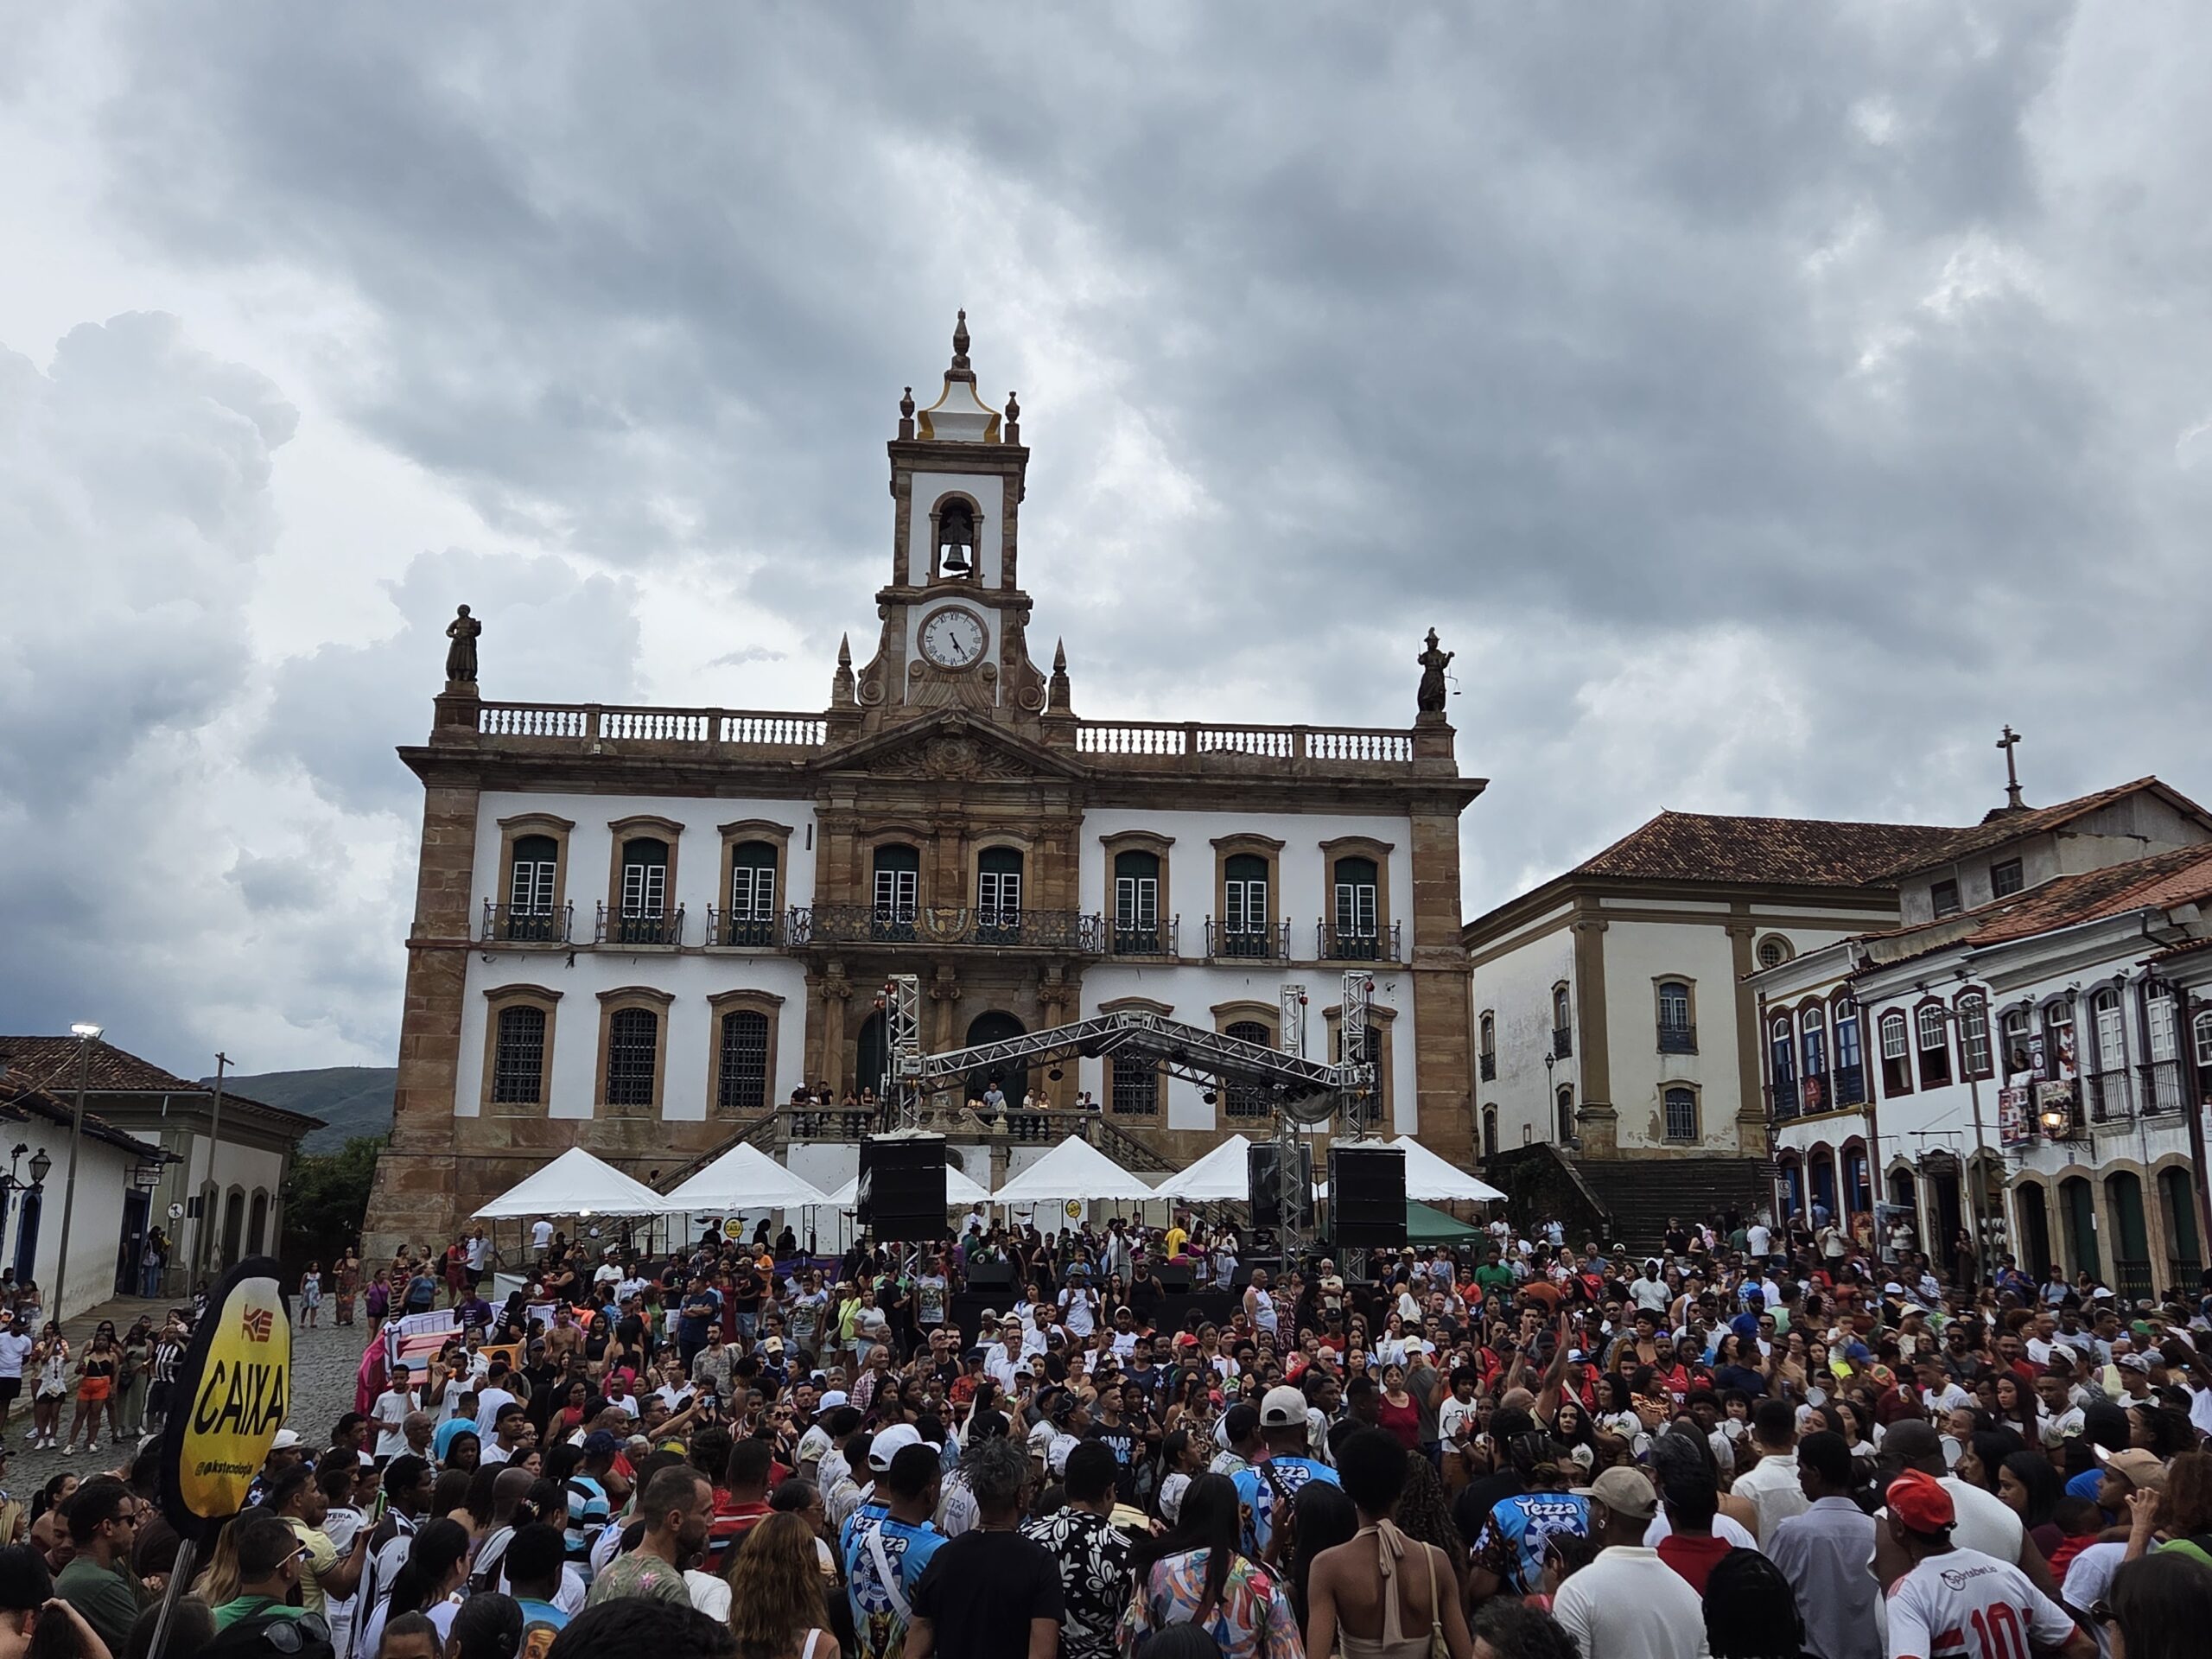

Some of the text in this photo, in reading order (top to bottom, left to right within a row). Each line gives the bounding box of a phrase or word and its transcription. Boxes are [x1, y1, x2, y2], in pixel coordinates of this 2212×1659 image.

[194, 1359, 284, 1436] CAIXA
[1245, 1465, 1310, 1479] Tzza
[1514, 1497, 1578, 1516] Tezza
[1970, 1601, 2027, 1659] 10
